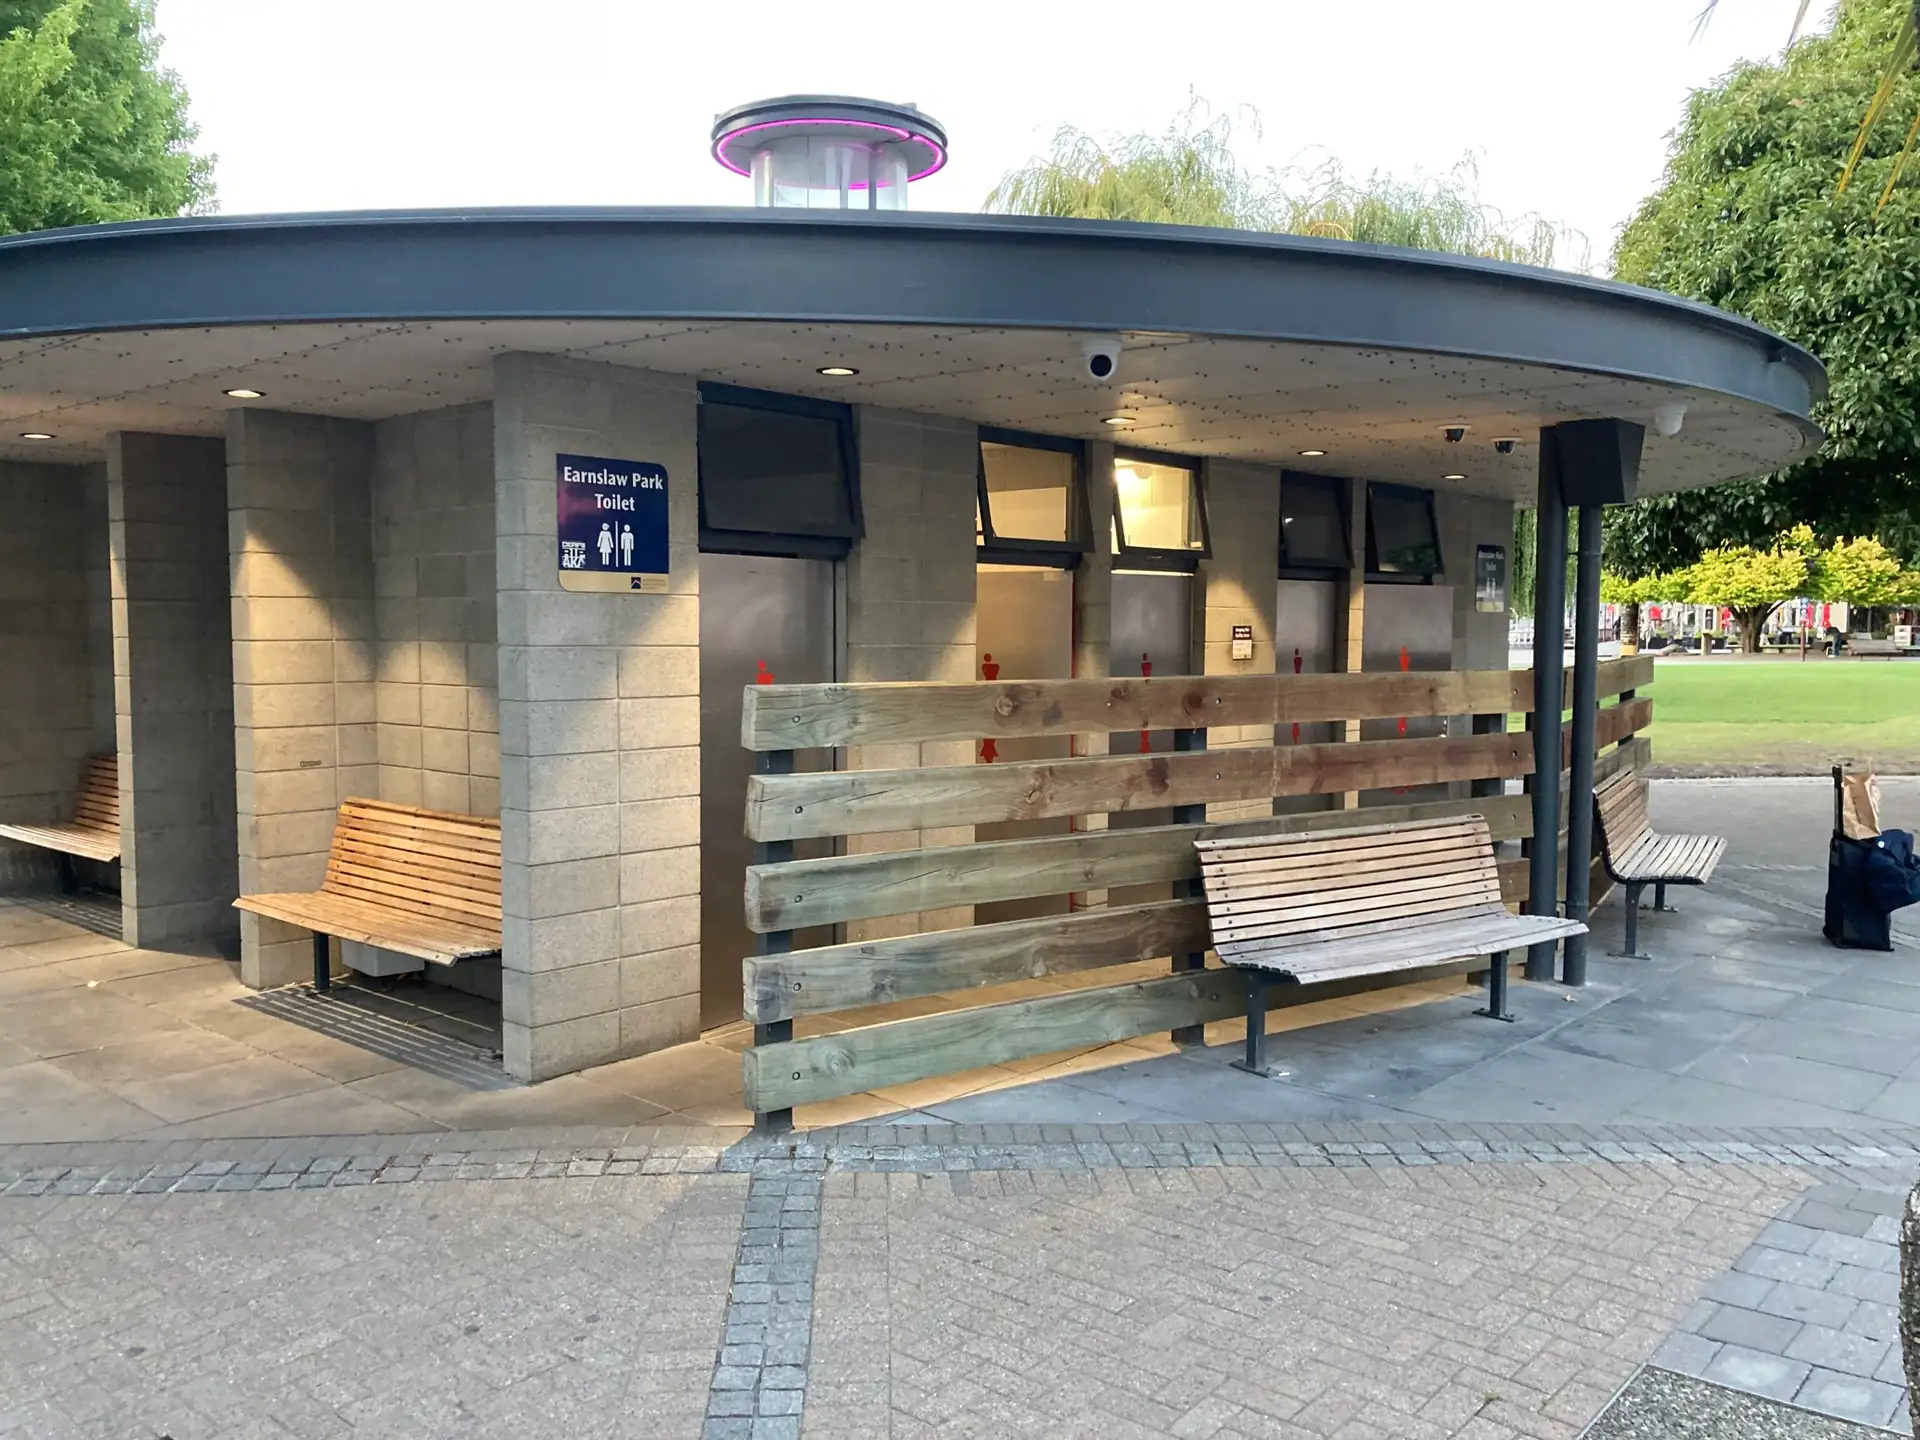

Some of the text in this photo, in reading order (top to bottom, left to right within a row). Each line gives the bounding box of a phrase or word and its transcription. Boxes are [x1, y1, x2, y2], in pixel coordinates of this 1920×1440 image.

[563, 466, 663, 490] Earnslaw Park
[594, 493, 636, 511] Toilet
